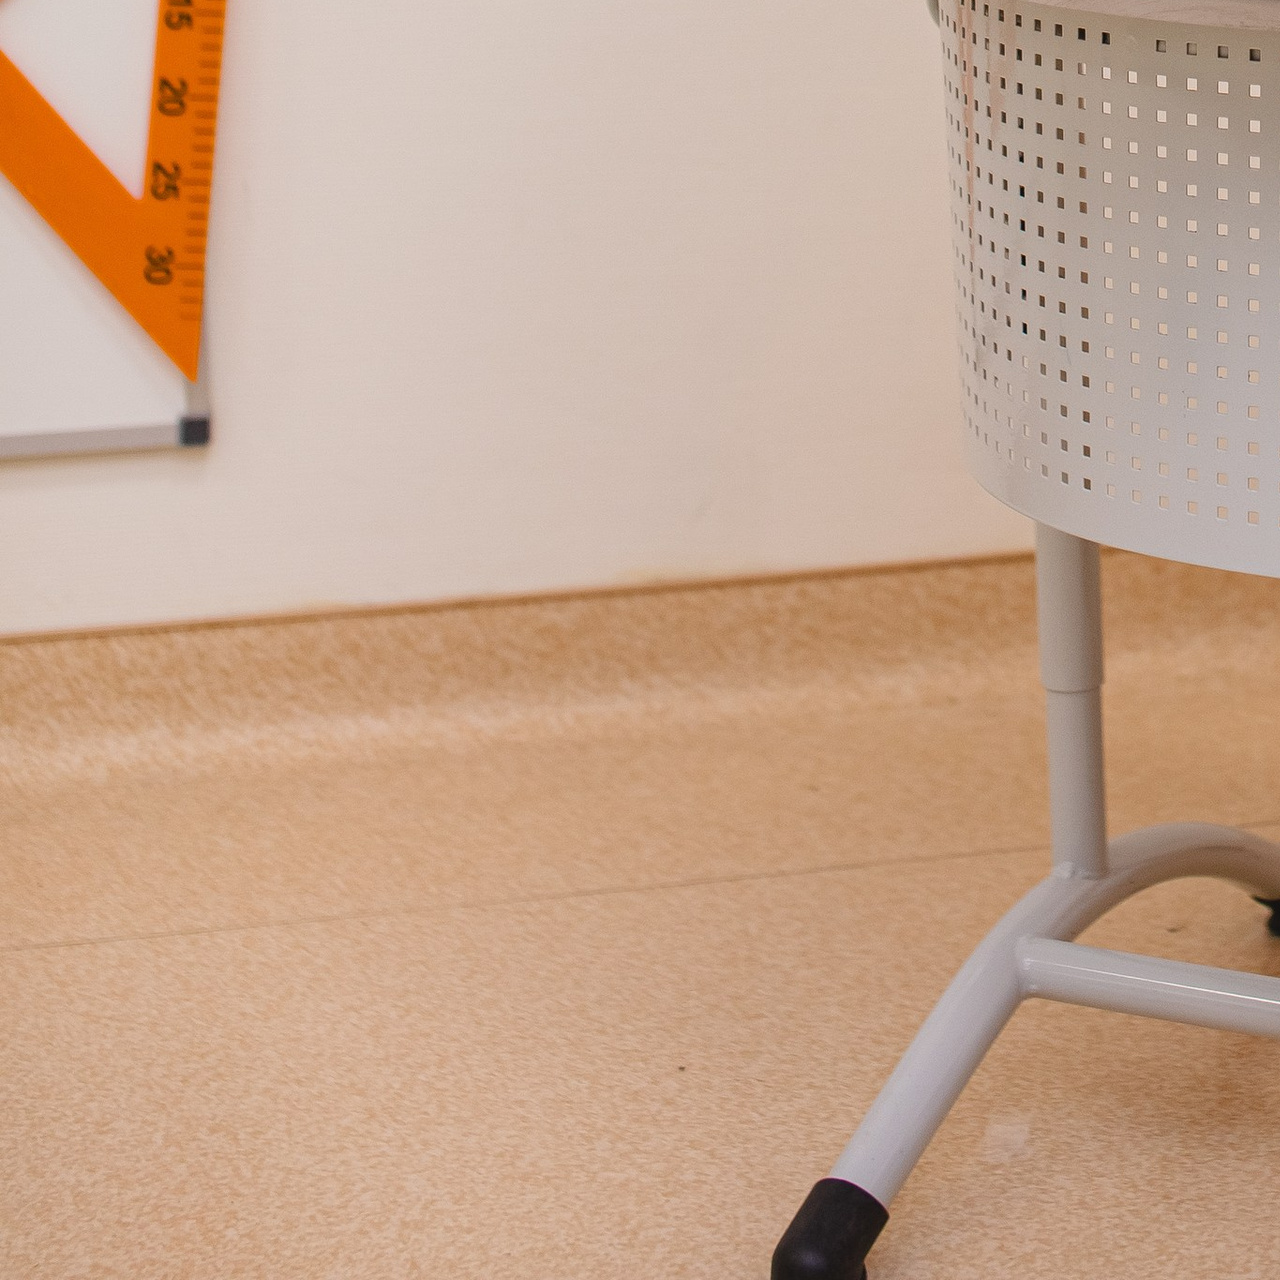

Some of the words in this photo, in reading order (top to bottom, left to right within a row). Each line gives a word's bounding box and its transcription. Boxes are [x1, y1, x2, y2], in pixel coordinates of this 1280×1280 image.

[157, 76, 188, 118] 20
[150, 160, 182, 202] 25
[143, 244, 176, 286] 30
